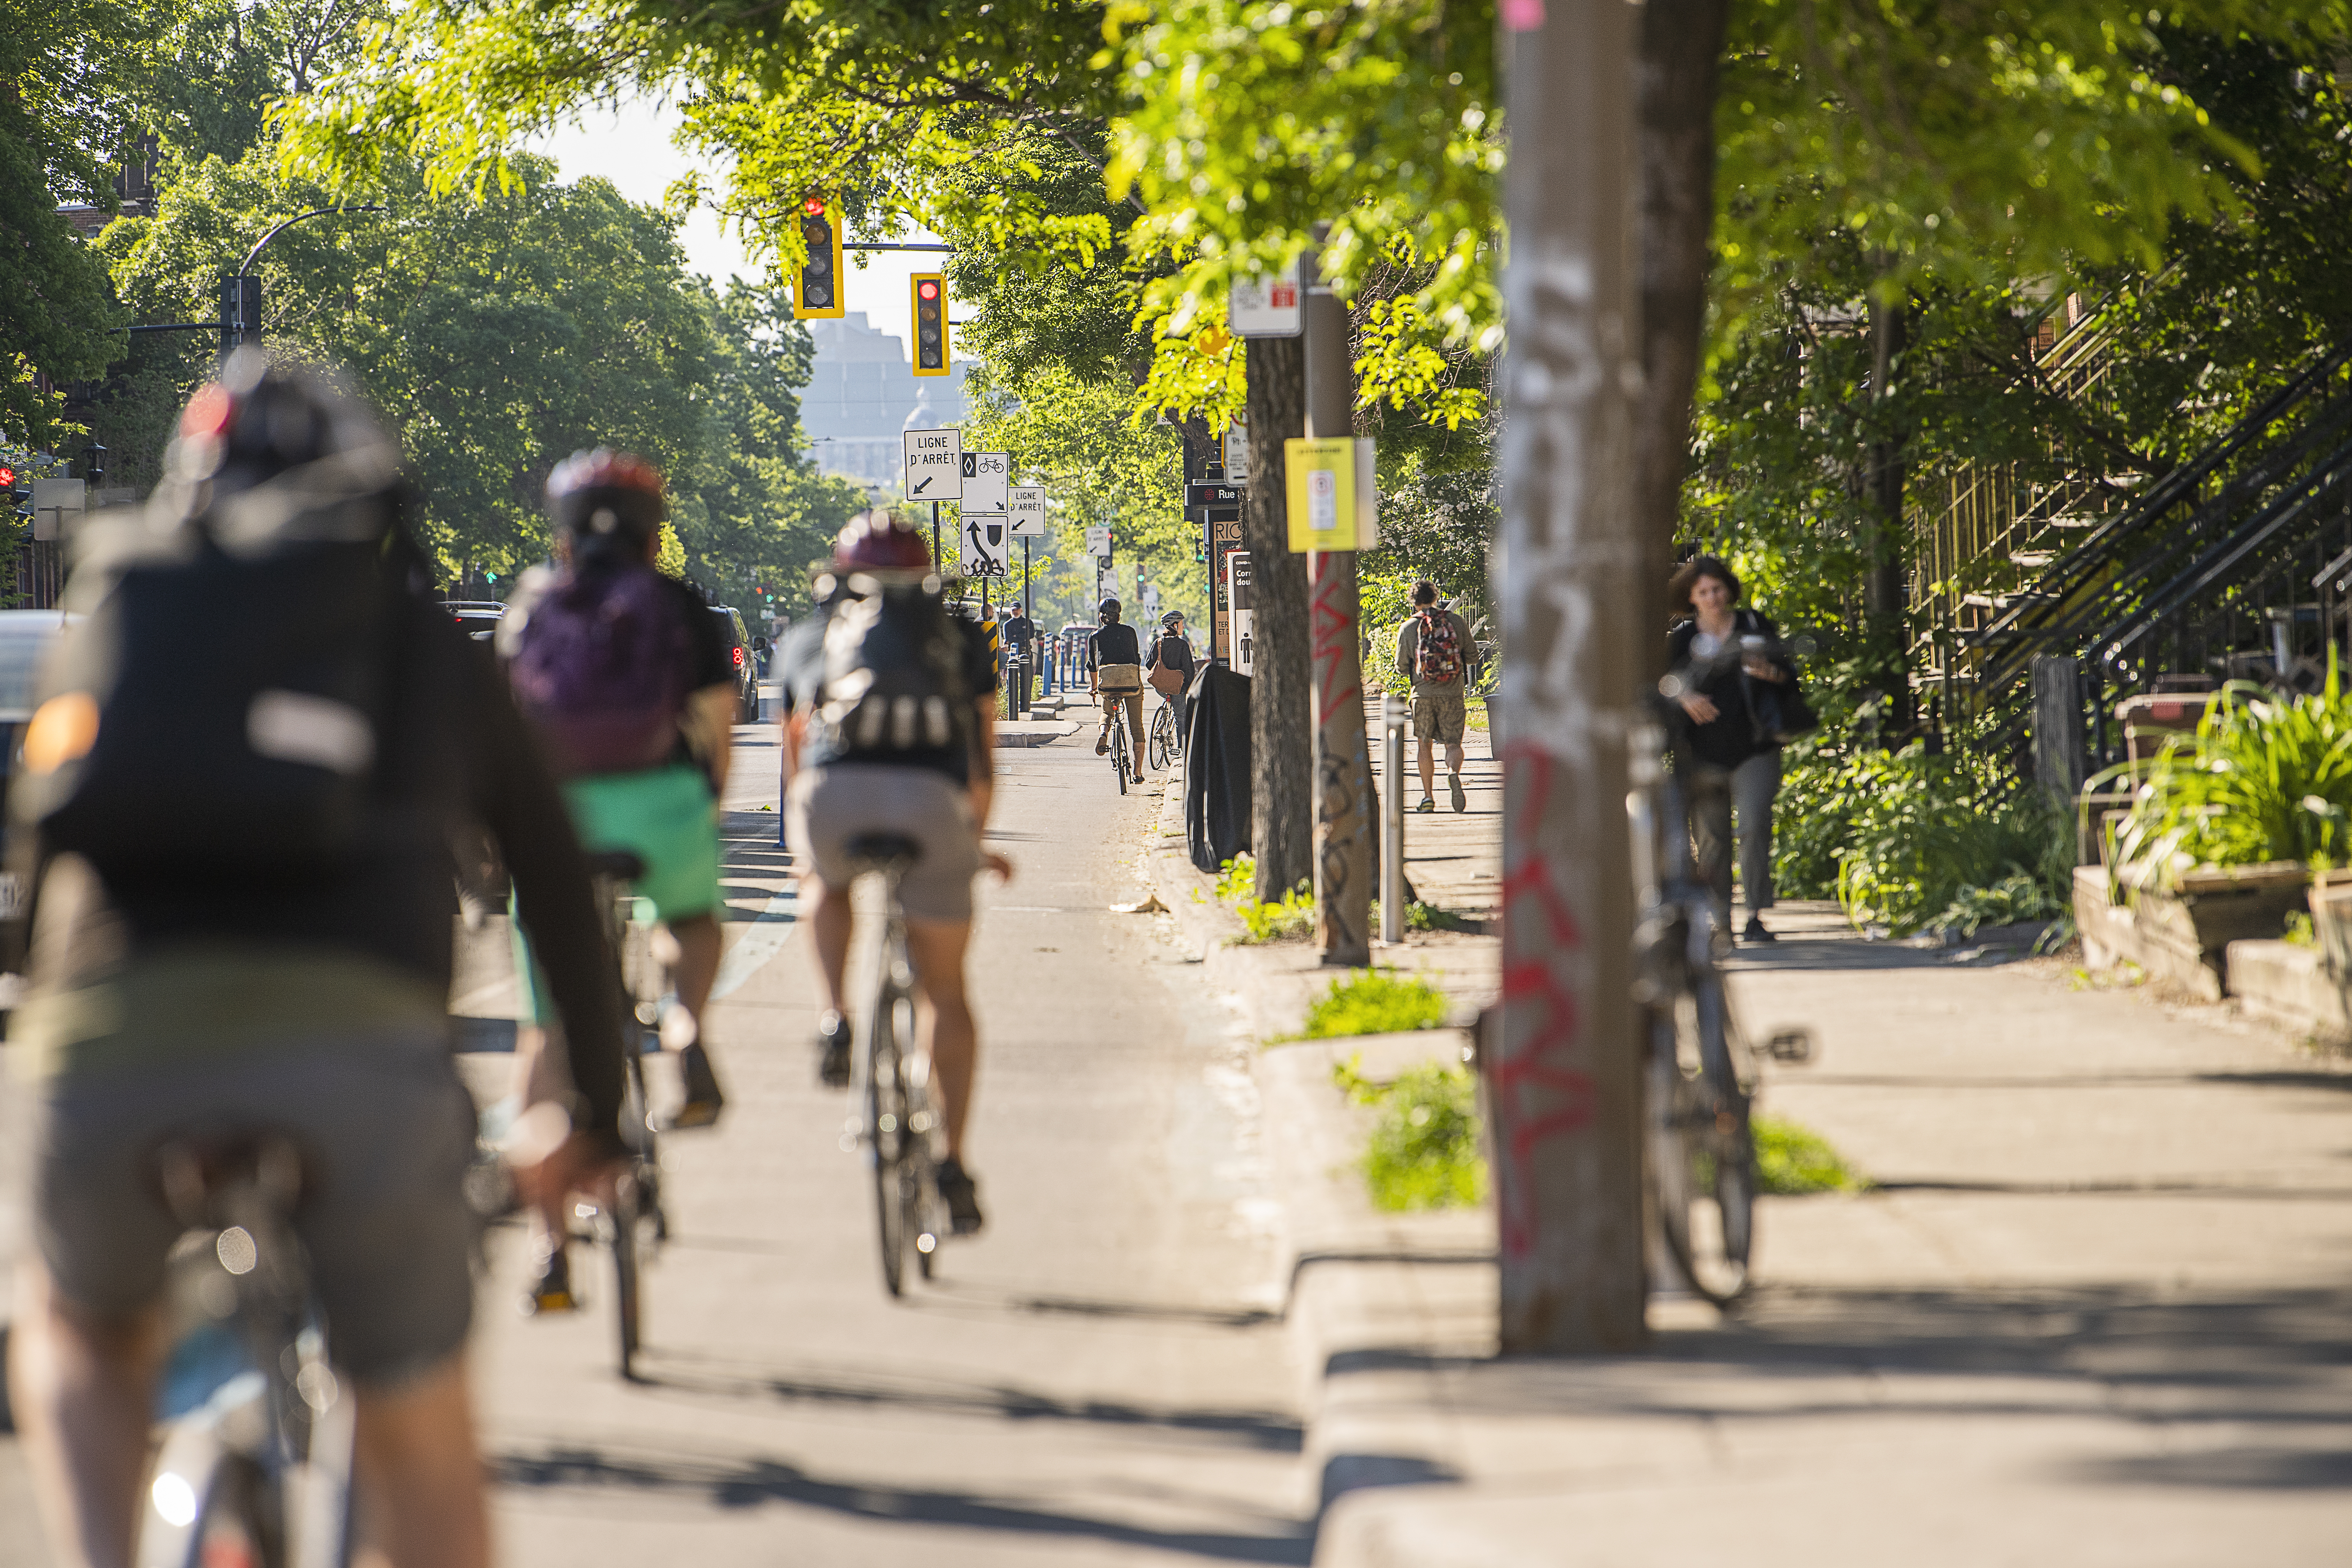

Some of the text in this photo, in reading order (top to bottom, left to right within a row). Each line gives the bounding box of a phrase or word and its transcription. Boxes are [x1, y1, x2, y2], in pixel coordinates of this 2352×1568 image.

[918, 437, 948, 448] LIGNE
[911, 451, 955, 465] D'ARRÊT
[1219, 490, 1235, 498] Rue
[1010, 502, 1041, 511] D'ARRÊT
